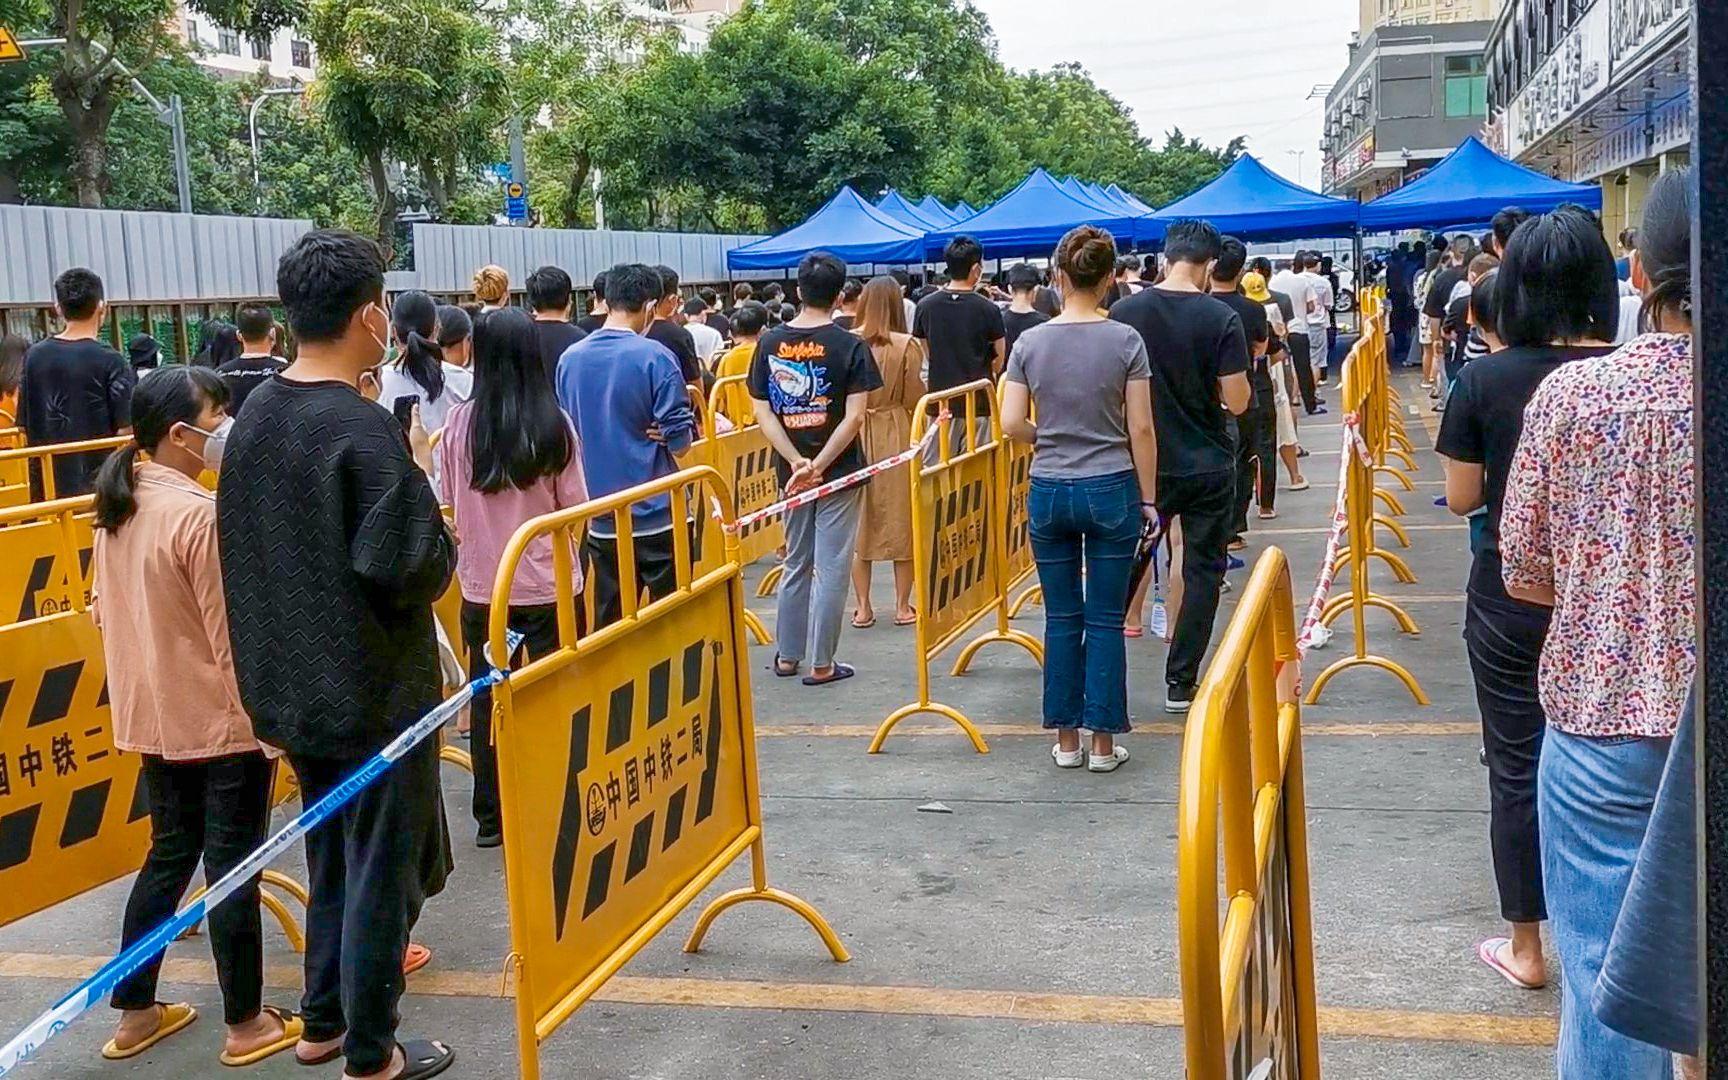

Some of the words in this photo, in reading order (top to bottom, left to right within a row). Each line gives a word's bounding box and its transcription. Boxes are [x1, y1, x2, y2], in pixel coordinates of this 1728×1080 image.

[0, 726, 122, 796] 中铁二
[606, 713, 703, 820] 中国中铁二局
